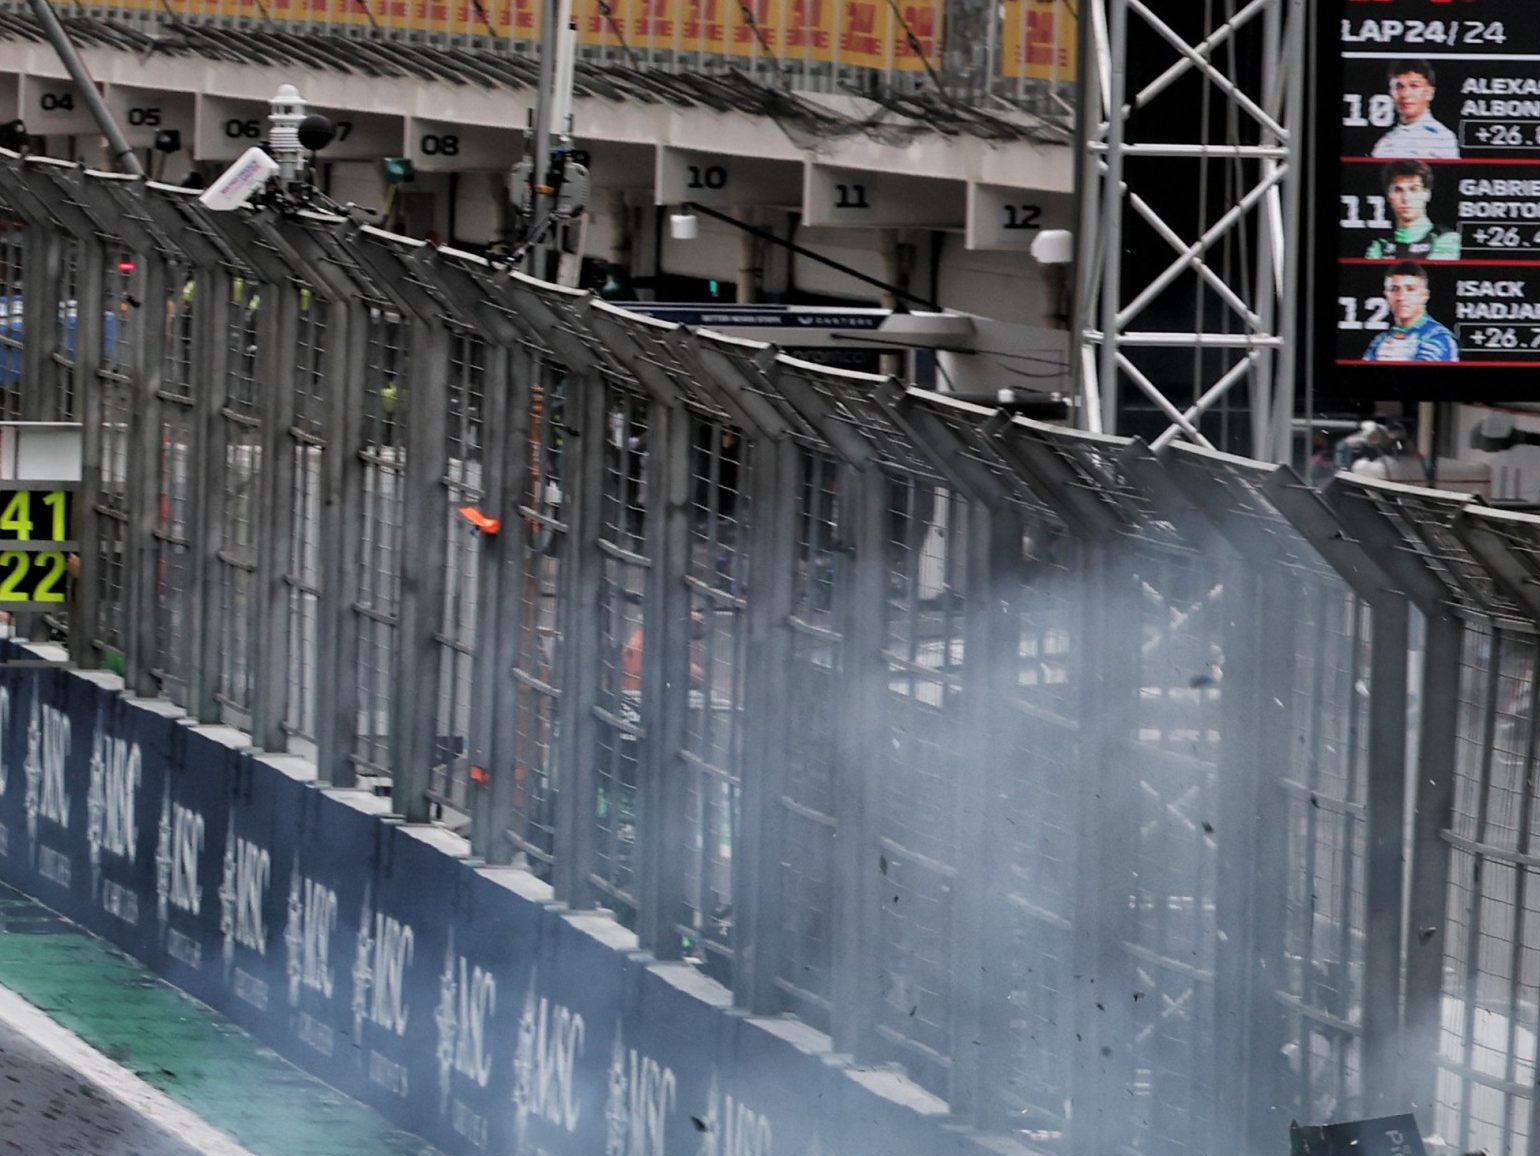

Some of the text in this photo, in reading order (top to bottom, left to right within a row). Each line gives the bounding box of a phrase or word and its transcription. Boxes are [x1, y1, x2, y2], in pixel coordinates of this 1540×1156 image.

[41, 94, 75, 111] 04
[1342, 94, 1396, 127] 10
[128, 108, 161, 126] 05
[225, 119, 261, 139] 06
[421, 134, 460, 156] 08
[687, 165, 728, 190] 10
[834, 185, 869, 209] 11
[1004, 205, 1042, 230] 12
[1340, 196, 1393, 229] 11
[1456, 280, 1525, 298] ISACK
[1338, 297, 1391, 330] 12
[0, 490, 67, 541] 41
[0, 550, 67, 602] 22
